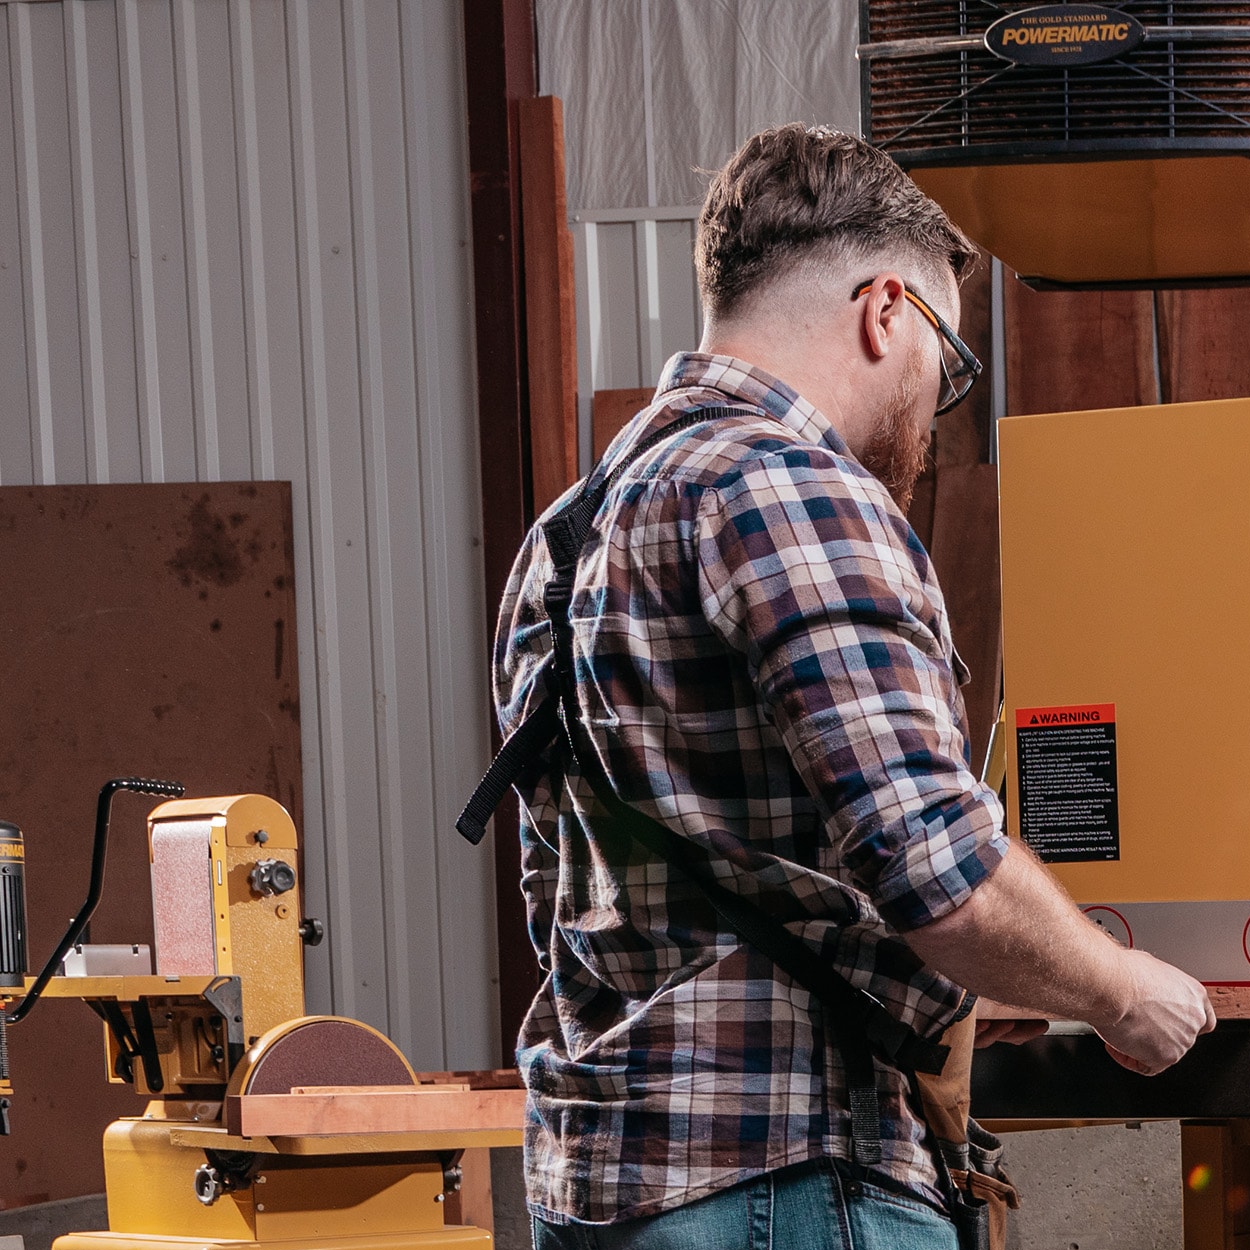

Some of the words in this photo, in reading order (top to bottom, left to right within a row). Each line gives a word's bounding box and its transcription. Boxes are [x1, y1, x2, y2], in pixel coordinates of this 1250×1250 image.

[1021, 17, 1038, 25] THE
[1063, 14, 1108, 22] STANDARD
[1002, 23, 1129, 46] POWERMATIC
[1051, 46, 1069, 54] SINCE
[1039, 711, 1100, 724] WARNING
